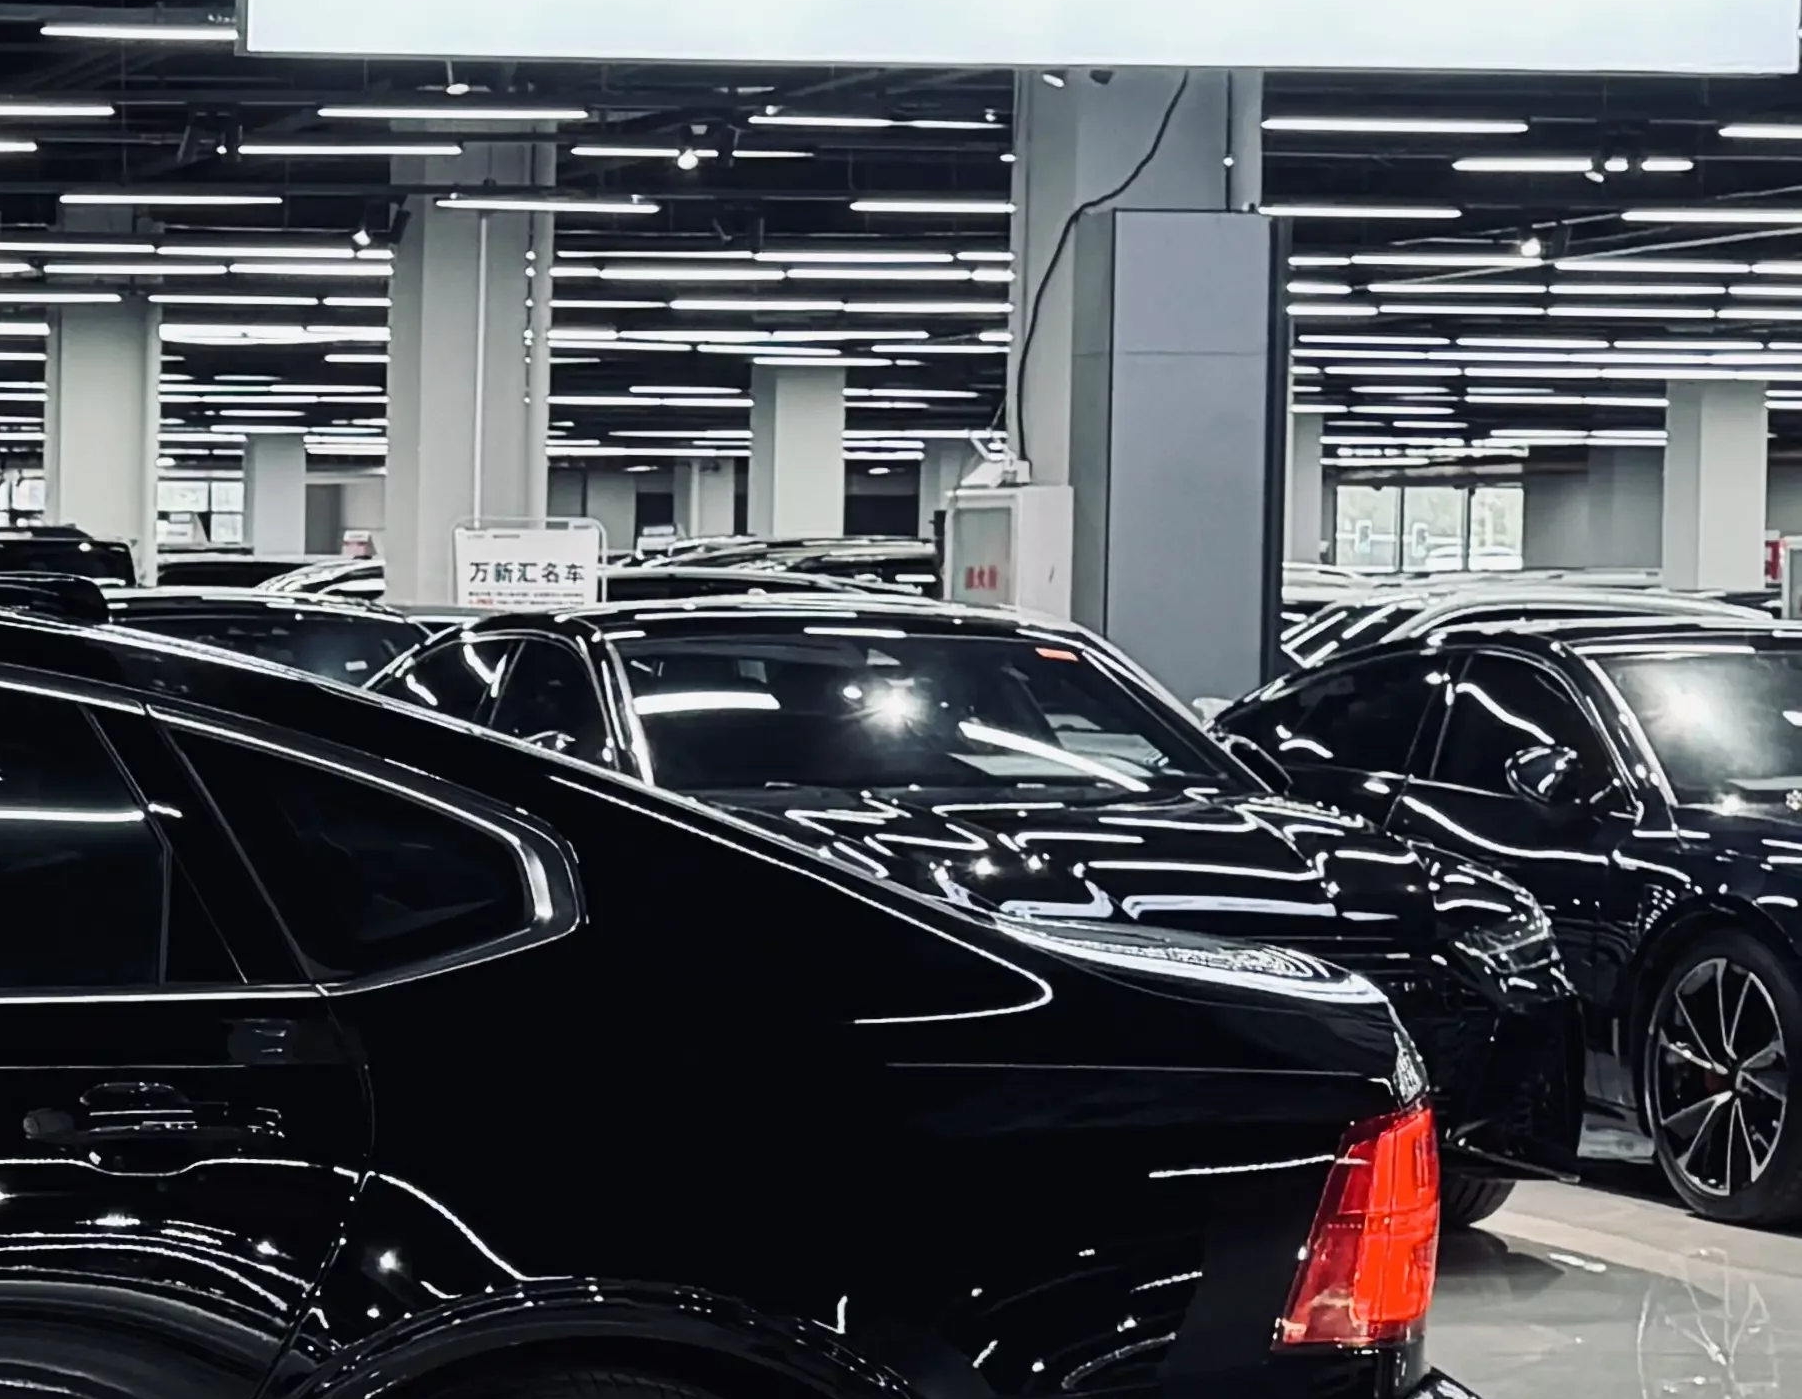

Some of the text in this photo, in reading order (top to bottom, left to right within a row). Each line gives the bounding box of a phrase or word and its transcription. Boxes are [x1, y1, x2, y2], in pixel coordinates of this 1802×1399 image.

[469, 562, 586, 584] 万新汇名车
